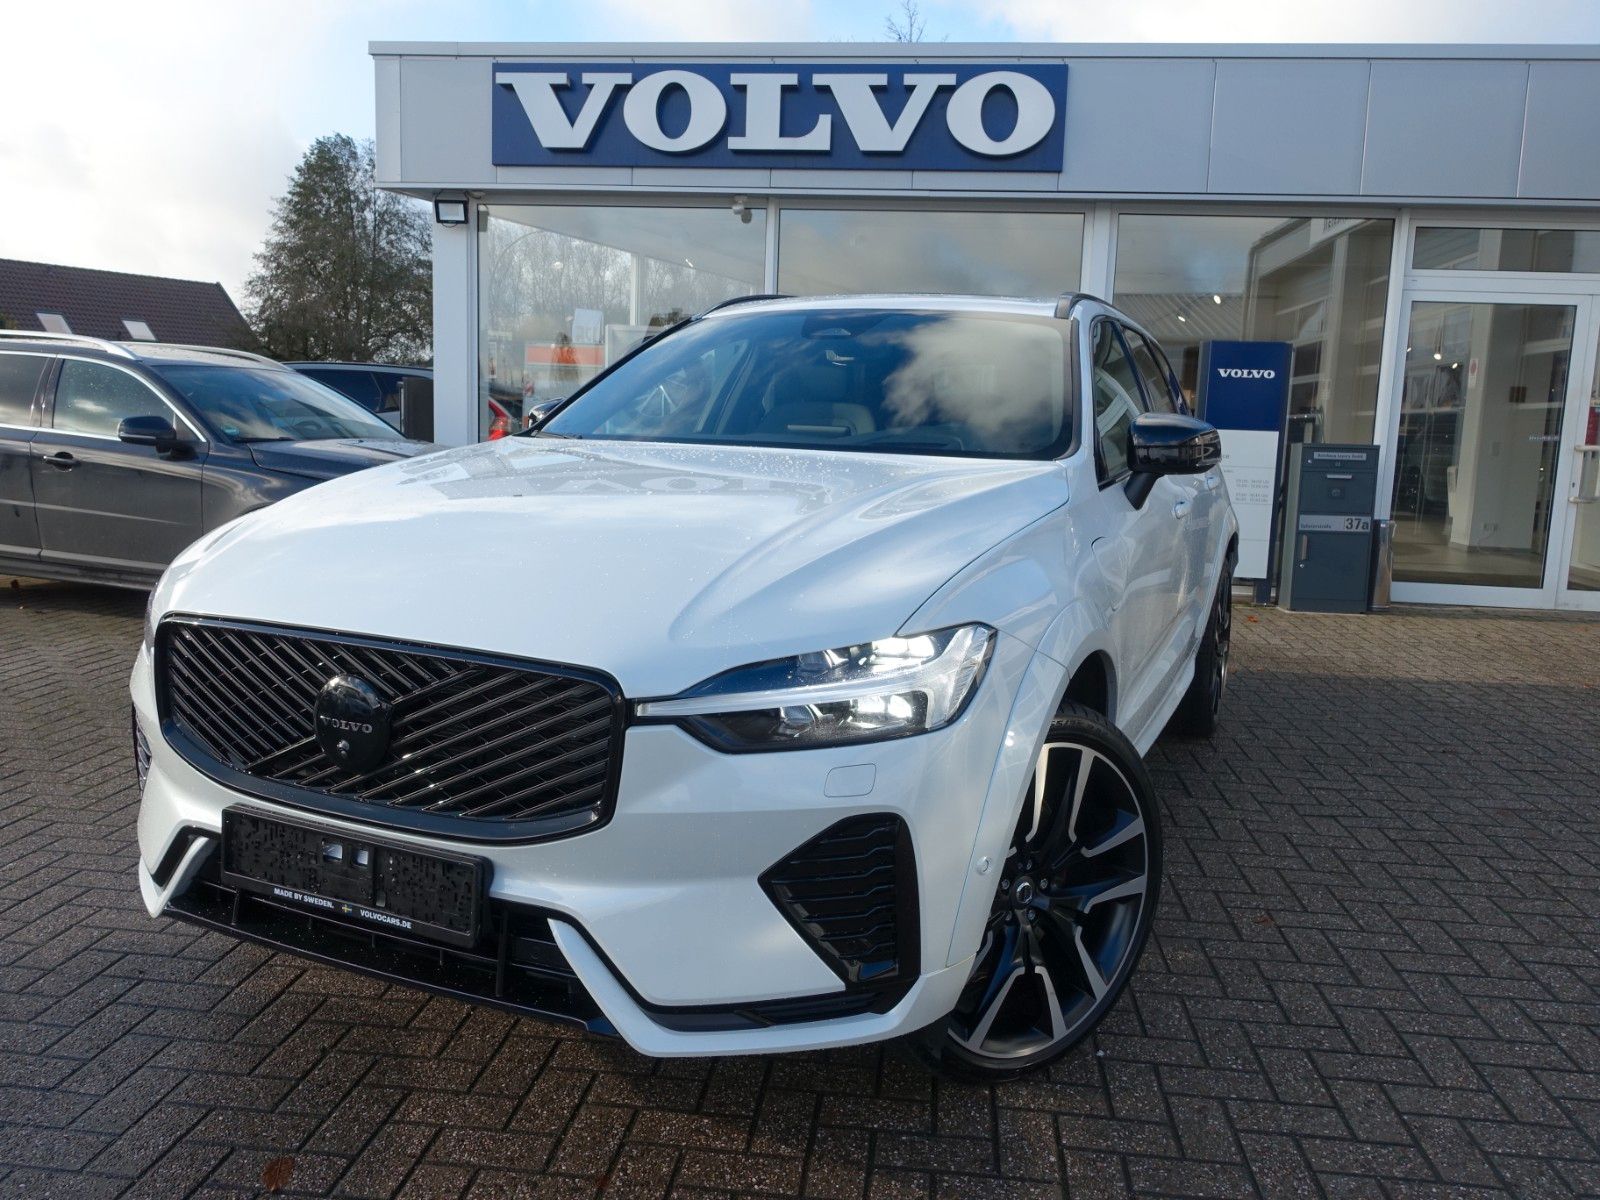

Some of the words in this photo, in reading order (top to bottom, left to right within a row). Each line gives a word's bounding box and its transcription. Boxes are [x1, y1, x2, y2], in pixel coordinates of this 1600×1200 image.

[495, 69, 1055, 156] VOLVO
[1217, 367, 1276, 379] VOLVO
[1345, 517, 1370, 530] 37a
[320, 715, 373, 734] VOLVO
[273, 887, 293, 899] MADE
[294, 892, 303, 901] BY
[303, 895, 335, 909] SWEDEN.
[360, 908, 412, 930] VOLVOCARS.DE
